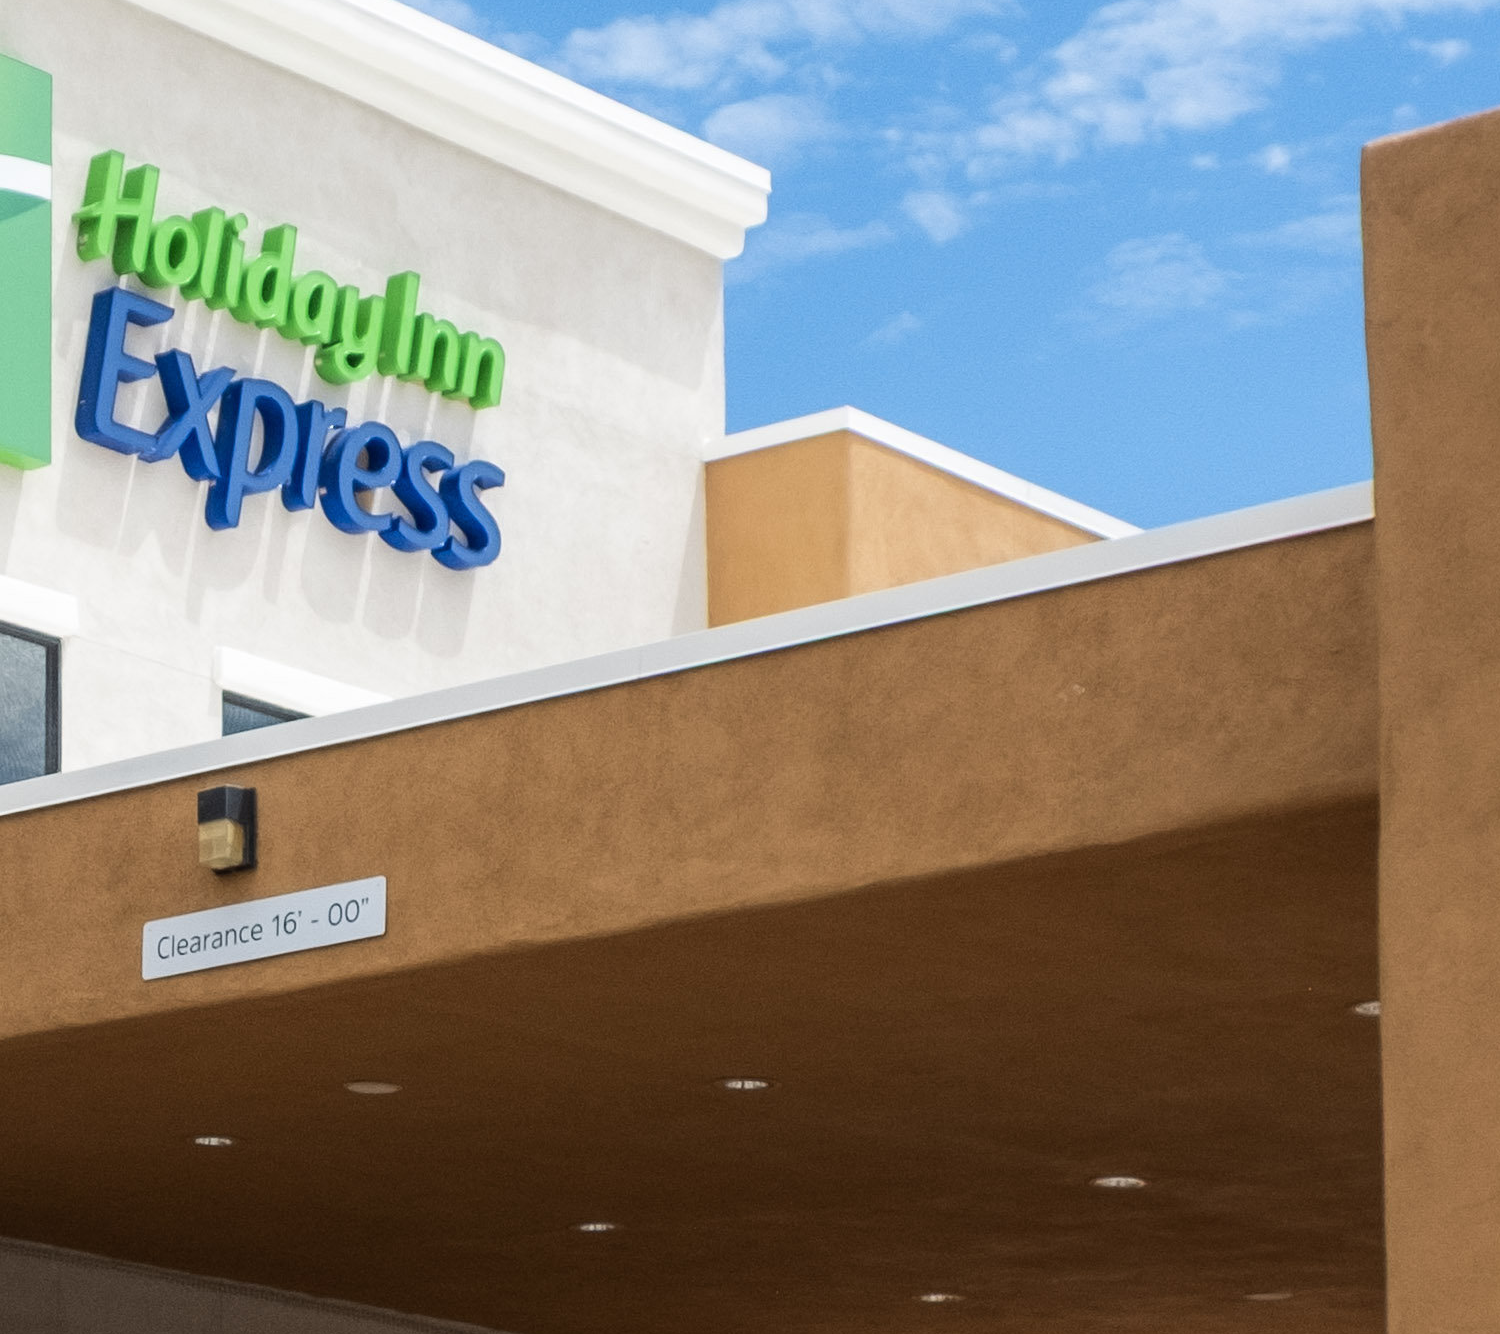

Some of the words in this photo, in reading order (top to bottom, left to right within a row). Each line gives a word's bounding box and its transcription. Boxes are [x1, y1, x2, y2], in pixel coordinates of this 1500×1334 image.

[72, 149, 387, 385] Holiday
[377, 270, 506, 410] Inn
[75, 286, 506, 571] Express
[156, 922, 264, 960] Clearance
[271, 910, 303, 937] 16'
